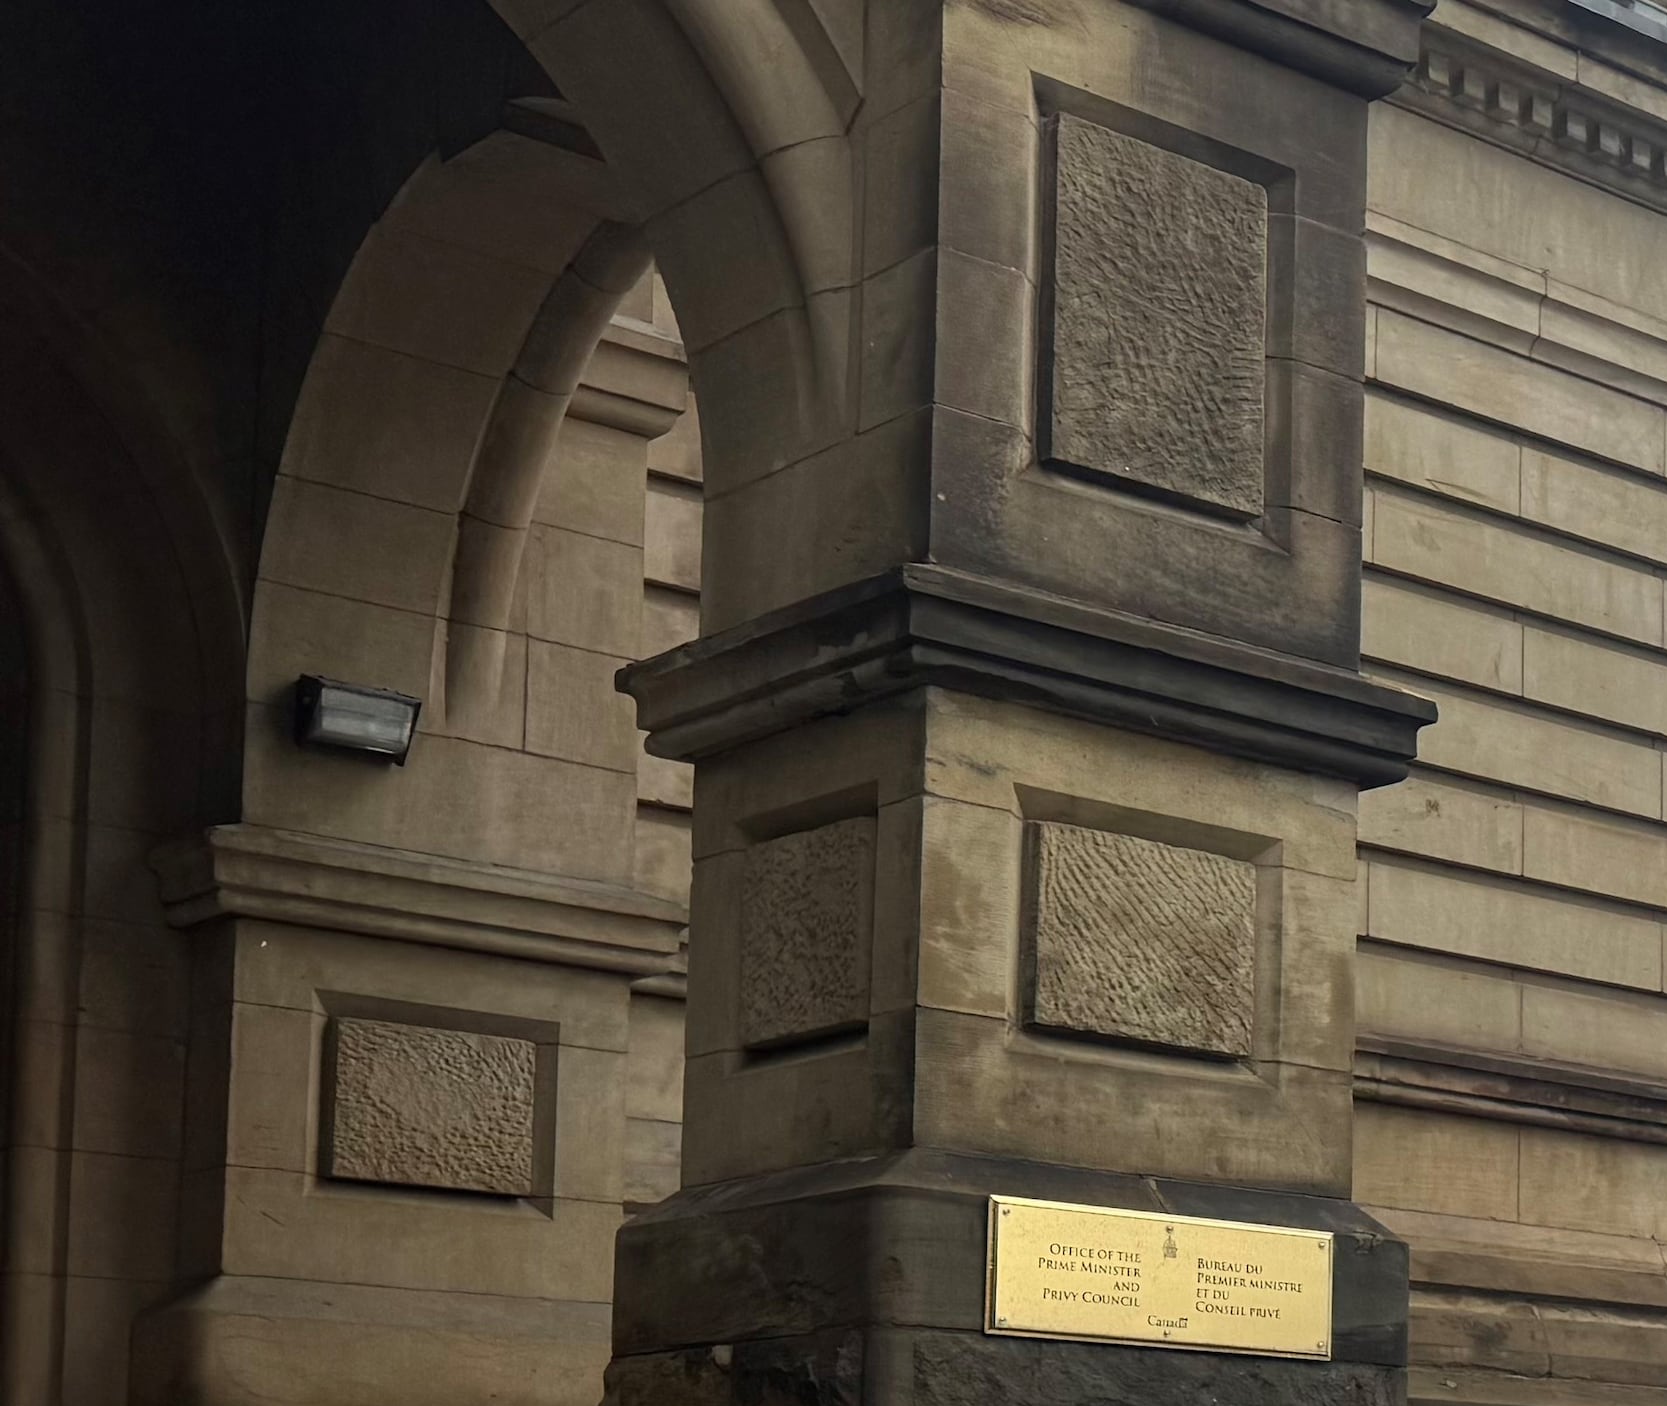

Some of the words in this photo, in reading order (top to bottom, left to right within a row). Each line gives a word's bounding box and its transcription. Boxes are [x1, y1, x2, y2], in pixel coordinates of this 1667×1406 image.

[1050, 1243, 1094, 1259] OFFICE
[1097, 1249, 1113, 1260] OF
[1117, 1251, 1142, 1263] THE
[1038, 1257, 1077, 1272] PRIME
[1080, 1261, 1142, 1278] MINISTER
[1197, 1258, 1242, 1273] BUREAU
[1246, 1264, 1263, 1274] DU
[1113, 1281, 1140, 1293] AND
[1197, 1272, 1247, 1288] PREMIER
[1249, 1280, 1302, 1293] MINISTRE
[1043, 1287, 1078, 1301] PRIVY
[1082, 1291, 1140, 1307] COUNCIL
[1196, 1288, 1209, 1299] ET
[1213, 1290, 1230, 1300] DU
[1195, 1301, 1246, 1316] CONSEIL
[1147, 1315, 1188, 1329] Canada
